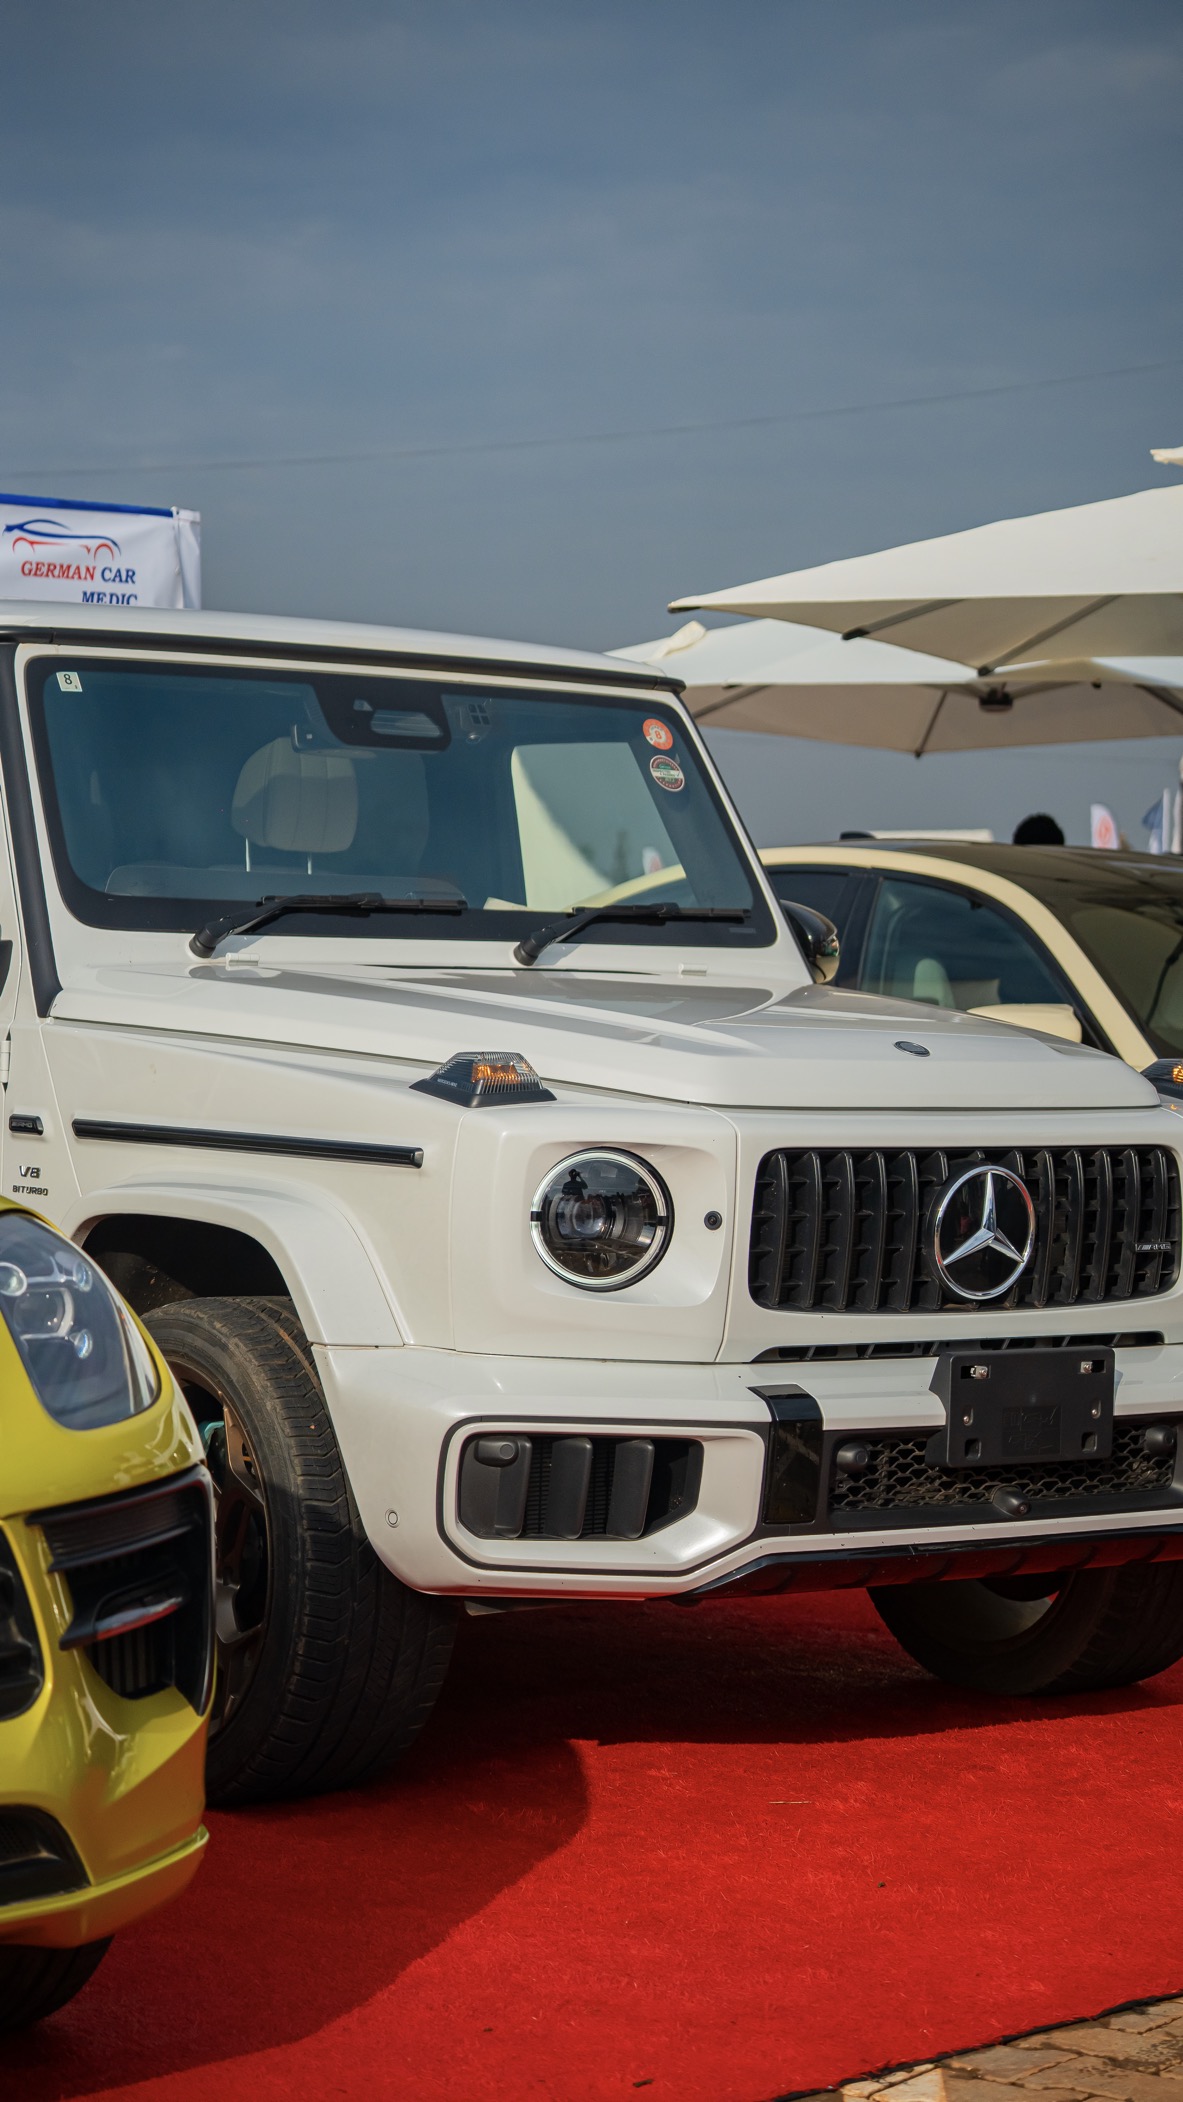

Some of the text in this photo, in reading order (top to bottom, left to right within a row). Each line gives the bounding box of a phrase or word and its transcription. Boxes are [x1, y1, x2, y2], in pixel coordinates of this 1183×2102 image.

[21, 561, 136, 584] GERMAN CAR
[64, 673, 72, 684] 8
[19, 1165, 41, 1179] V8
[12, 1185, 48, 1196] BITURBO
